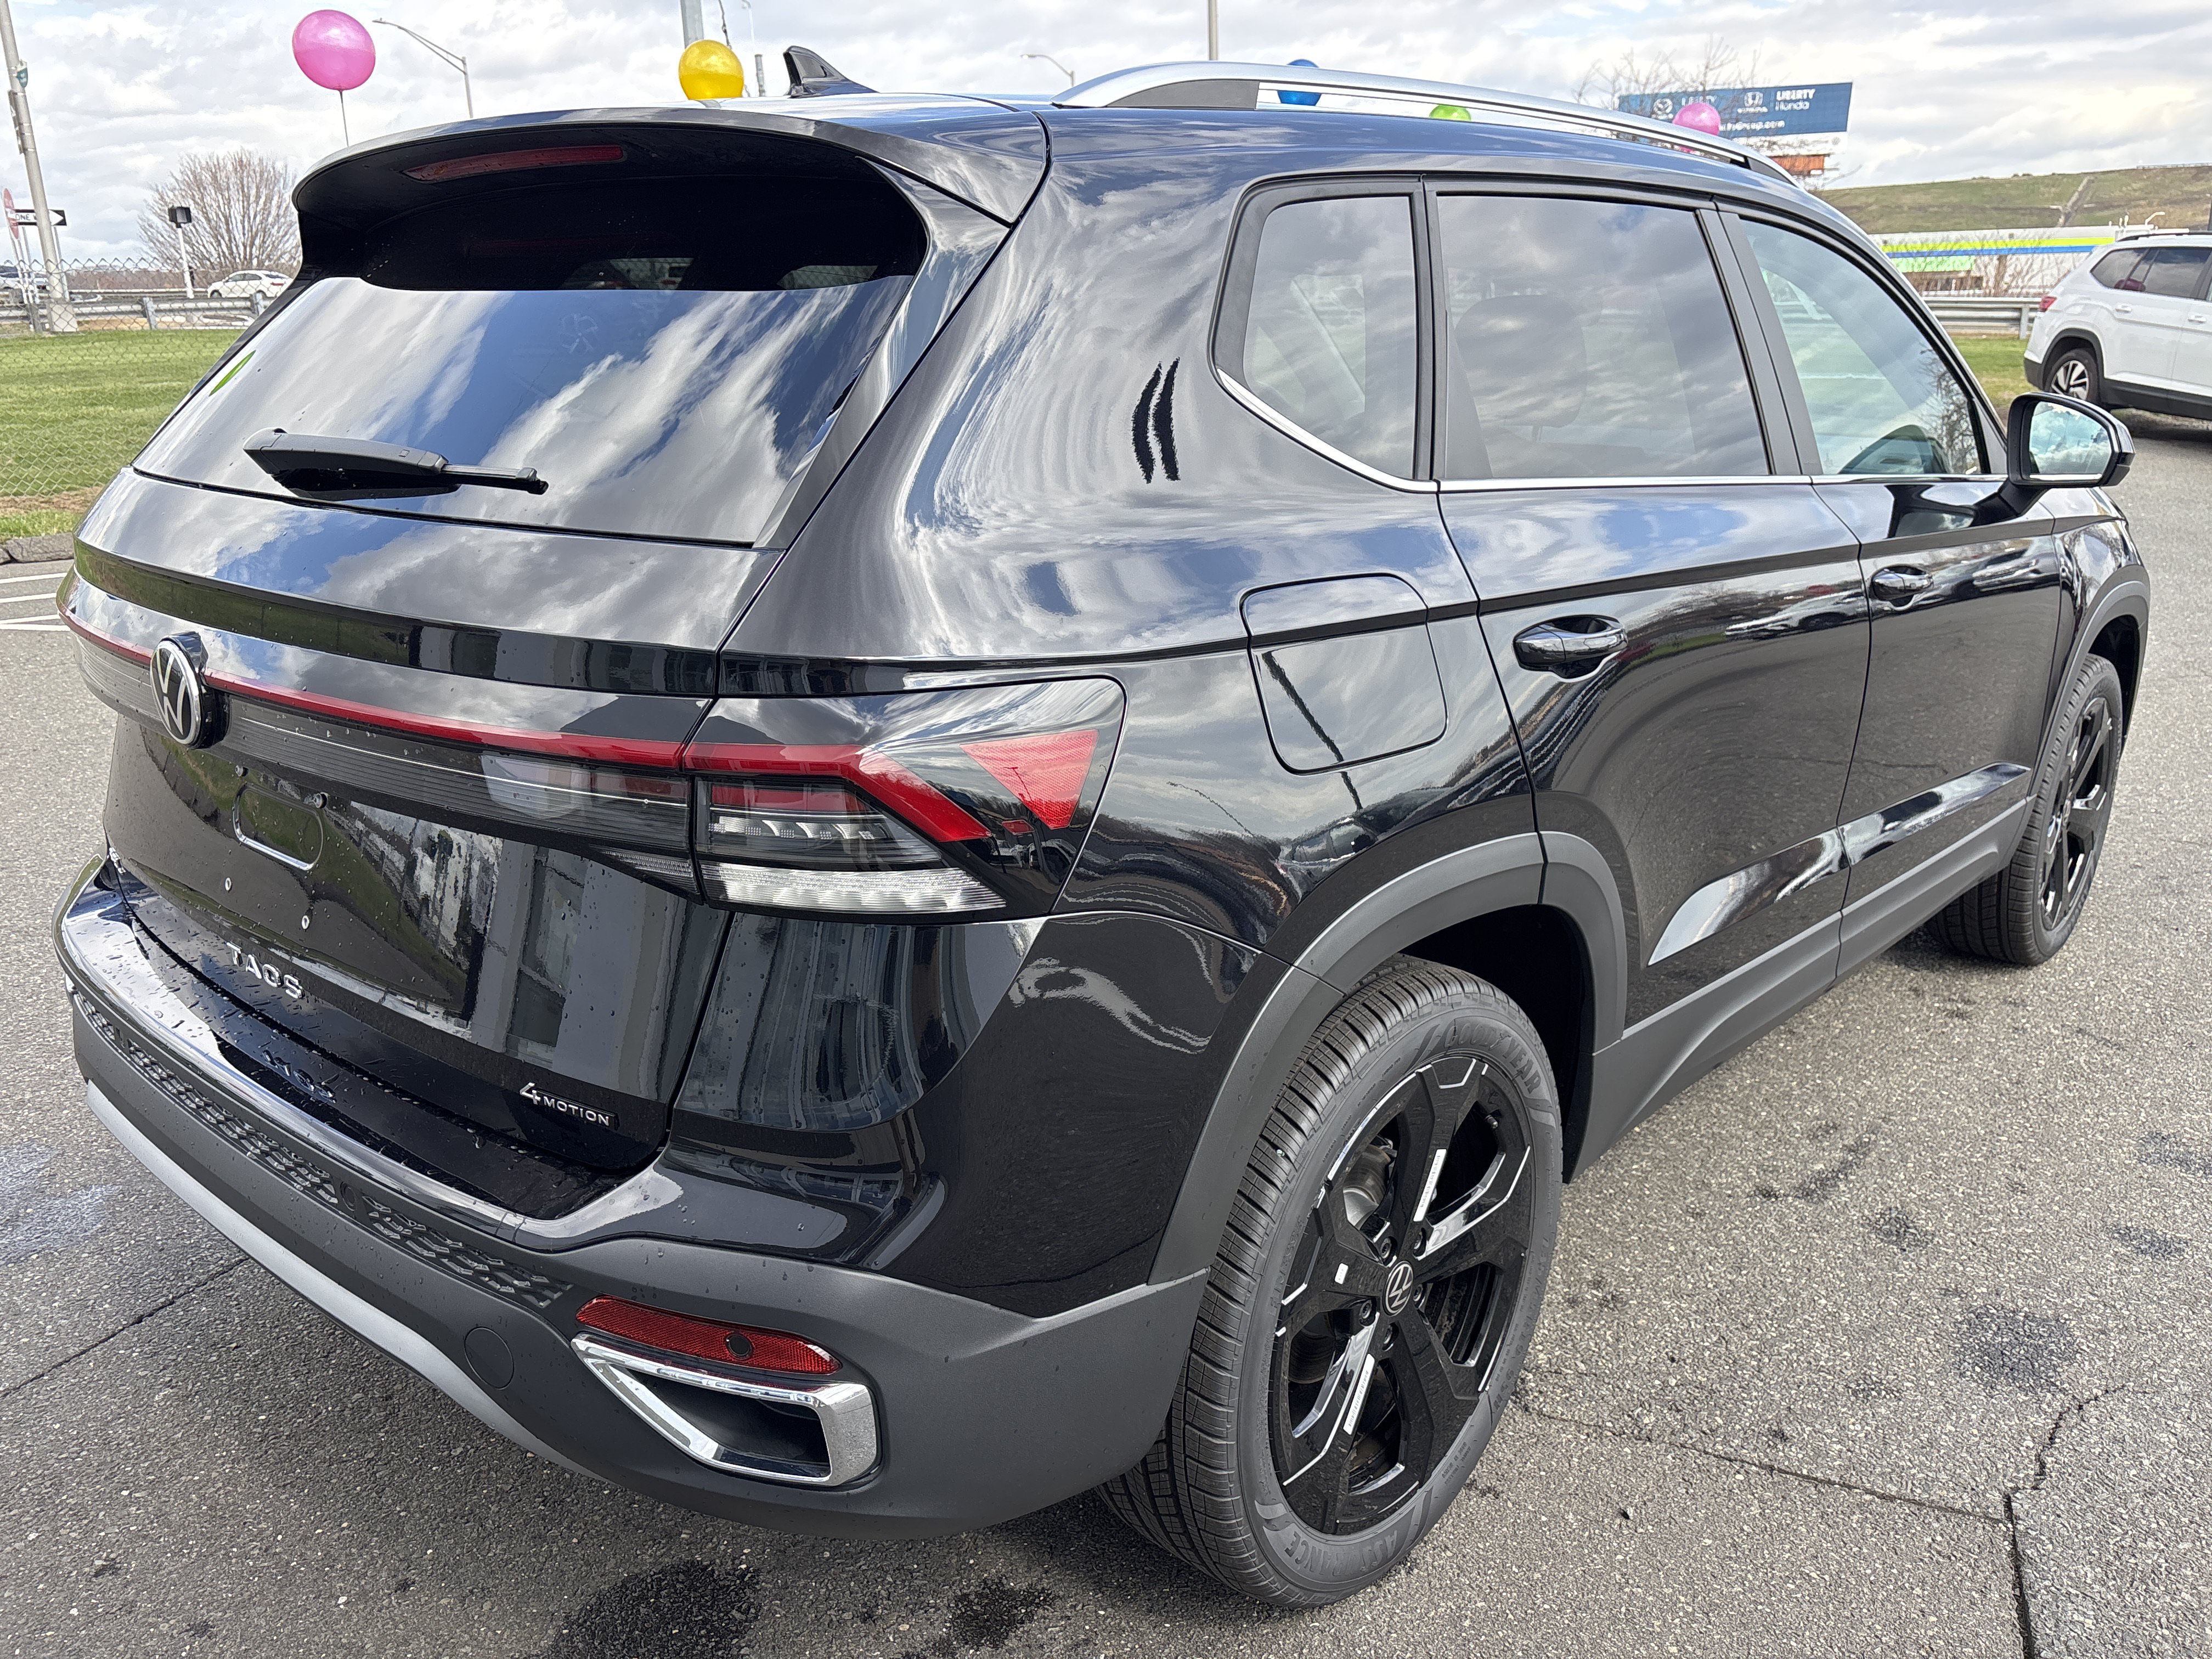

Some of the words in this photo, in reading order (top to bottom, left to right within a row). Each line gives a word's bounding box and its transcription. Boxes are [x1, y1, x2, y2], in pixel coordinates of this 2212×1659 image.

[1776, 88, 1815, 101] LIBERTY
[1775, 101, 1810, 111] Honda
[226, 941, 305, 999] TAOS
